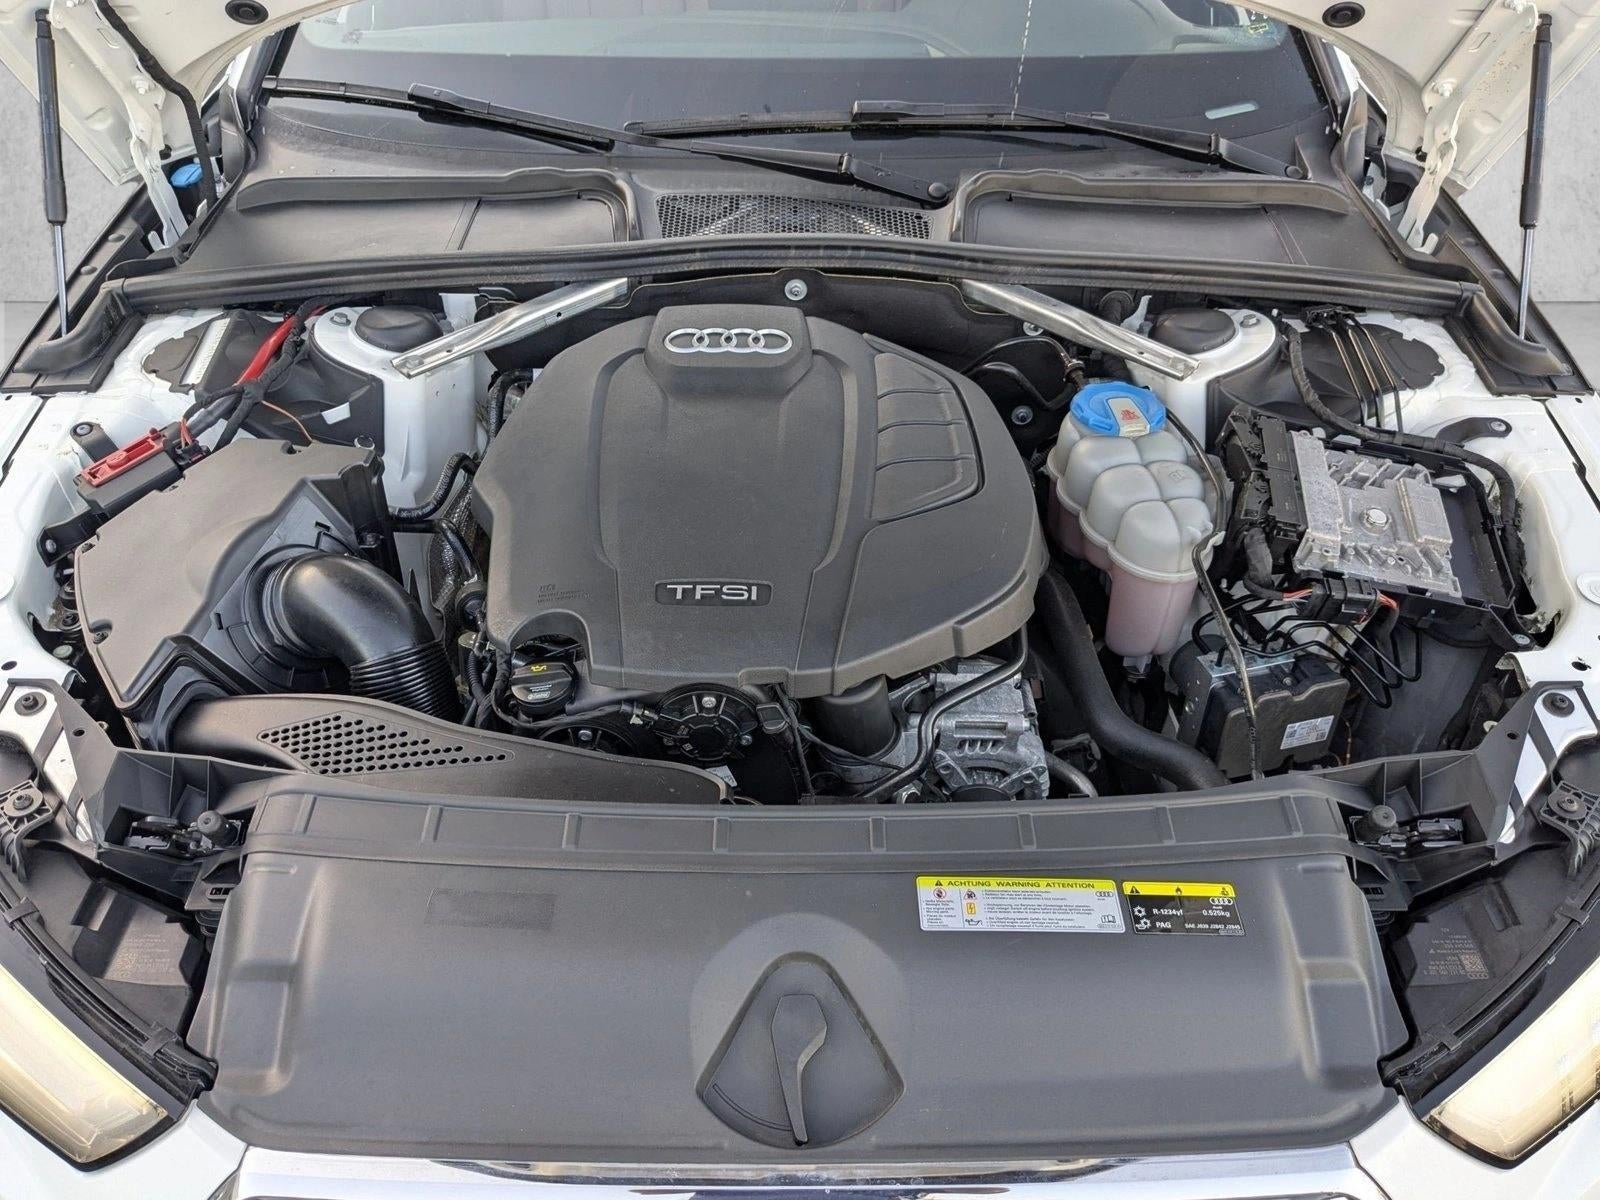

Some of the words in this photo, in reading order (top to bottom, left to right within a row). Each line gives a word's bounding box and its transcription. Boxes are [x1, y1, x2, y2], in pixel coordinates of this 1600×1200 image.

[666, 584, 758, 601] TFSI
[947, 880, 992, 888] ACHTUNG
[996, 881, 1041, 889] WARNING
[1045, 881, 1095, 889] ATTENTION
[1202, 909, 1231, 918] 0.525kg
[1155, 921, 1172, 929] PAG
